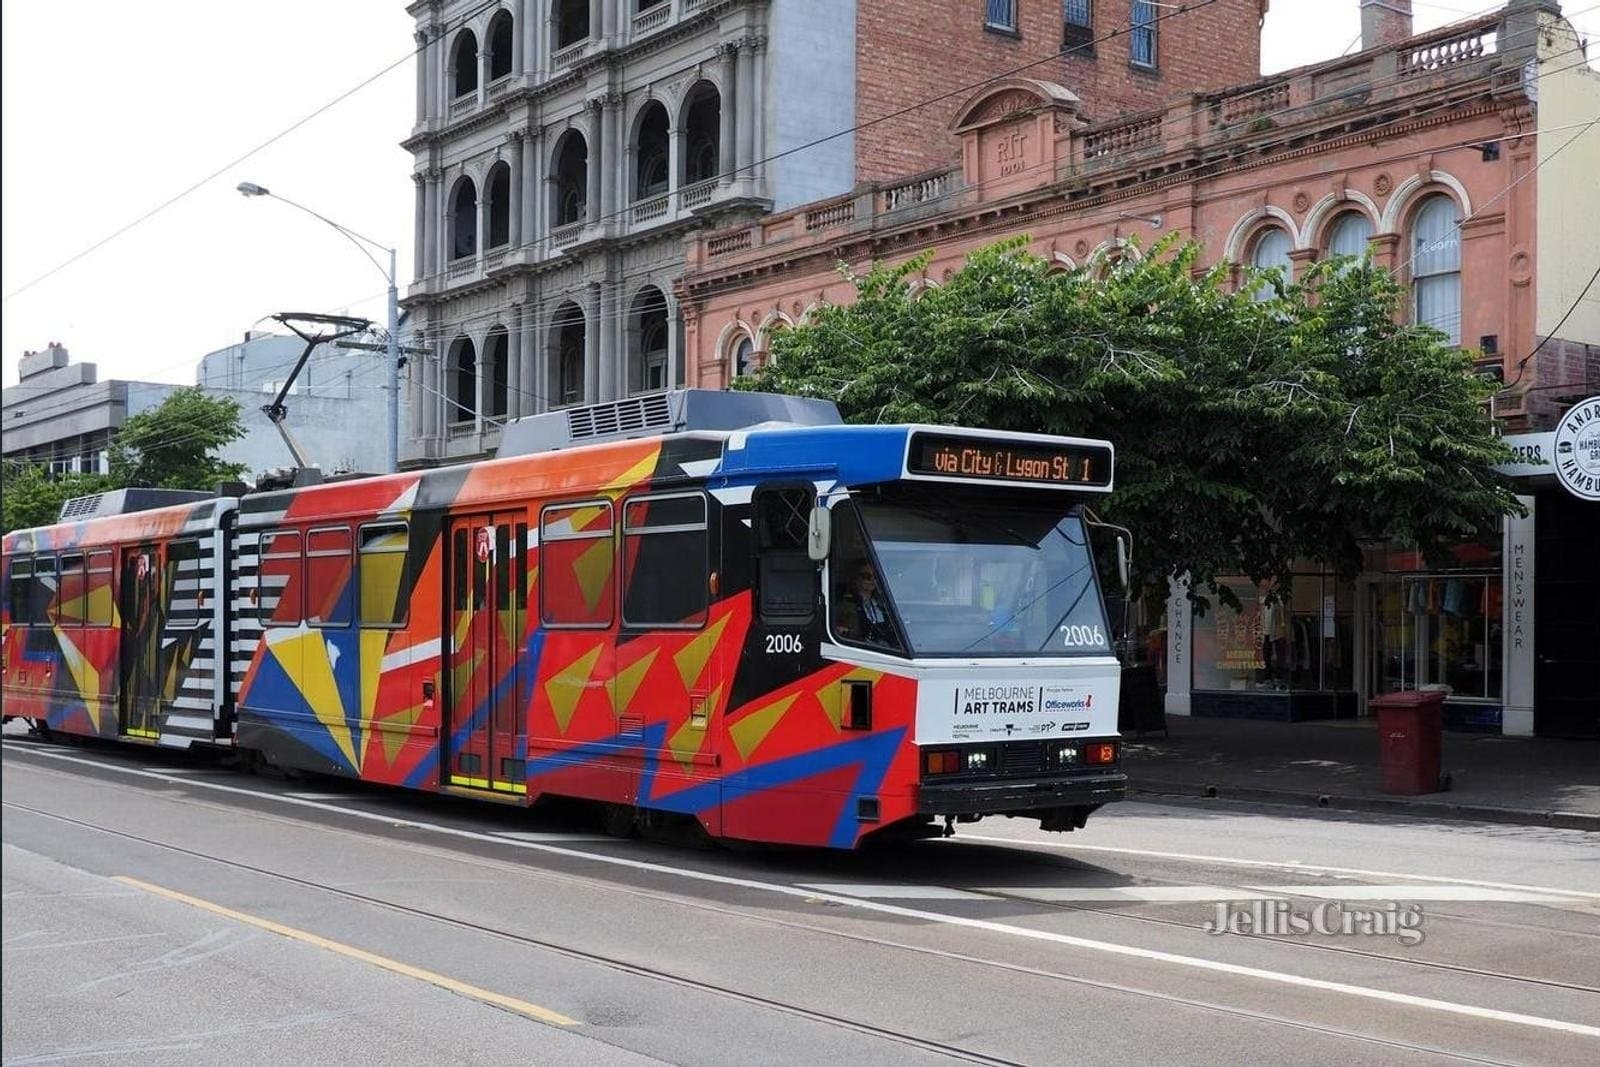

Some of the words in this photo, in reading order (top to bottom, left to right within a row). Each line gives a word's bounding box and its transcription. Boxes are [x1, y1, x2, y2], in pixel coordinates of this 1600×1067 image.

[935, 447, 957, 472] via
[961, 449, 992, 475] City
[1053, 455, 1069, 480] St
[1081, 458, 1089, 481] 1
[1512, 544, 1526, 649] MENSWEAR
[765, 634, 802, 653] 2006
[1060, 624, 1105, 646] 2006
[964, 686, 1035, 700] MELBOURNE
[963, 701, 989, 715] ART
[991, 700, 1034, 714] TRAMS
[1044, 699, 1086, 710] Officeworks
